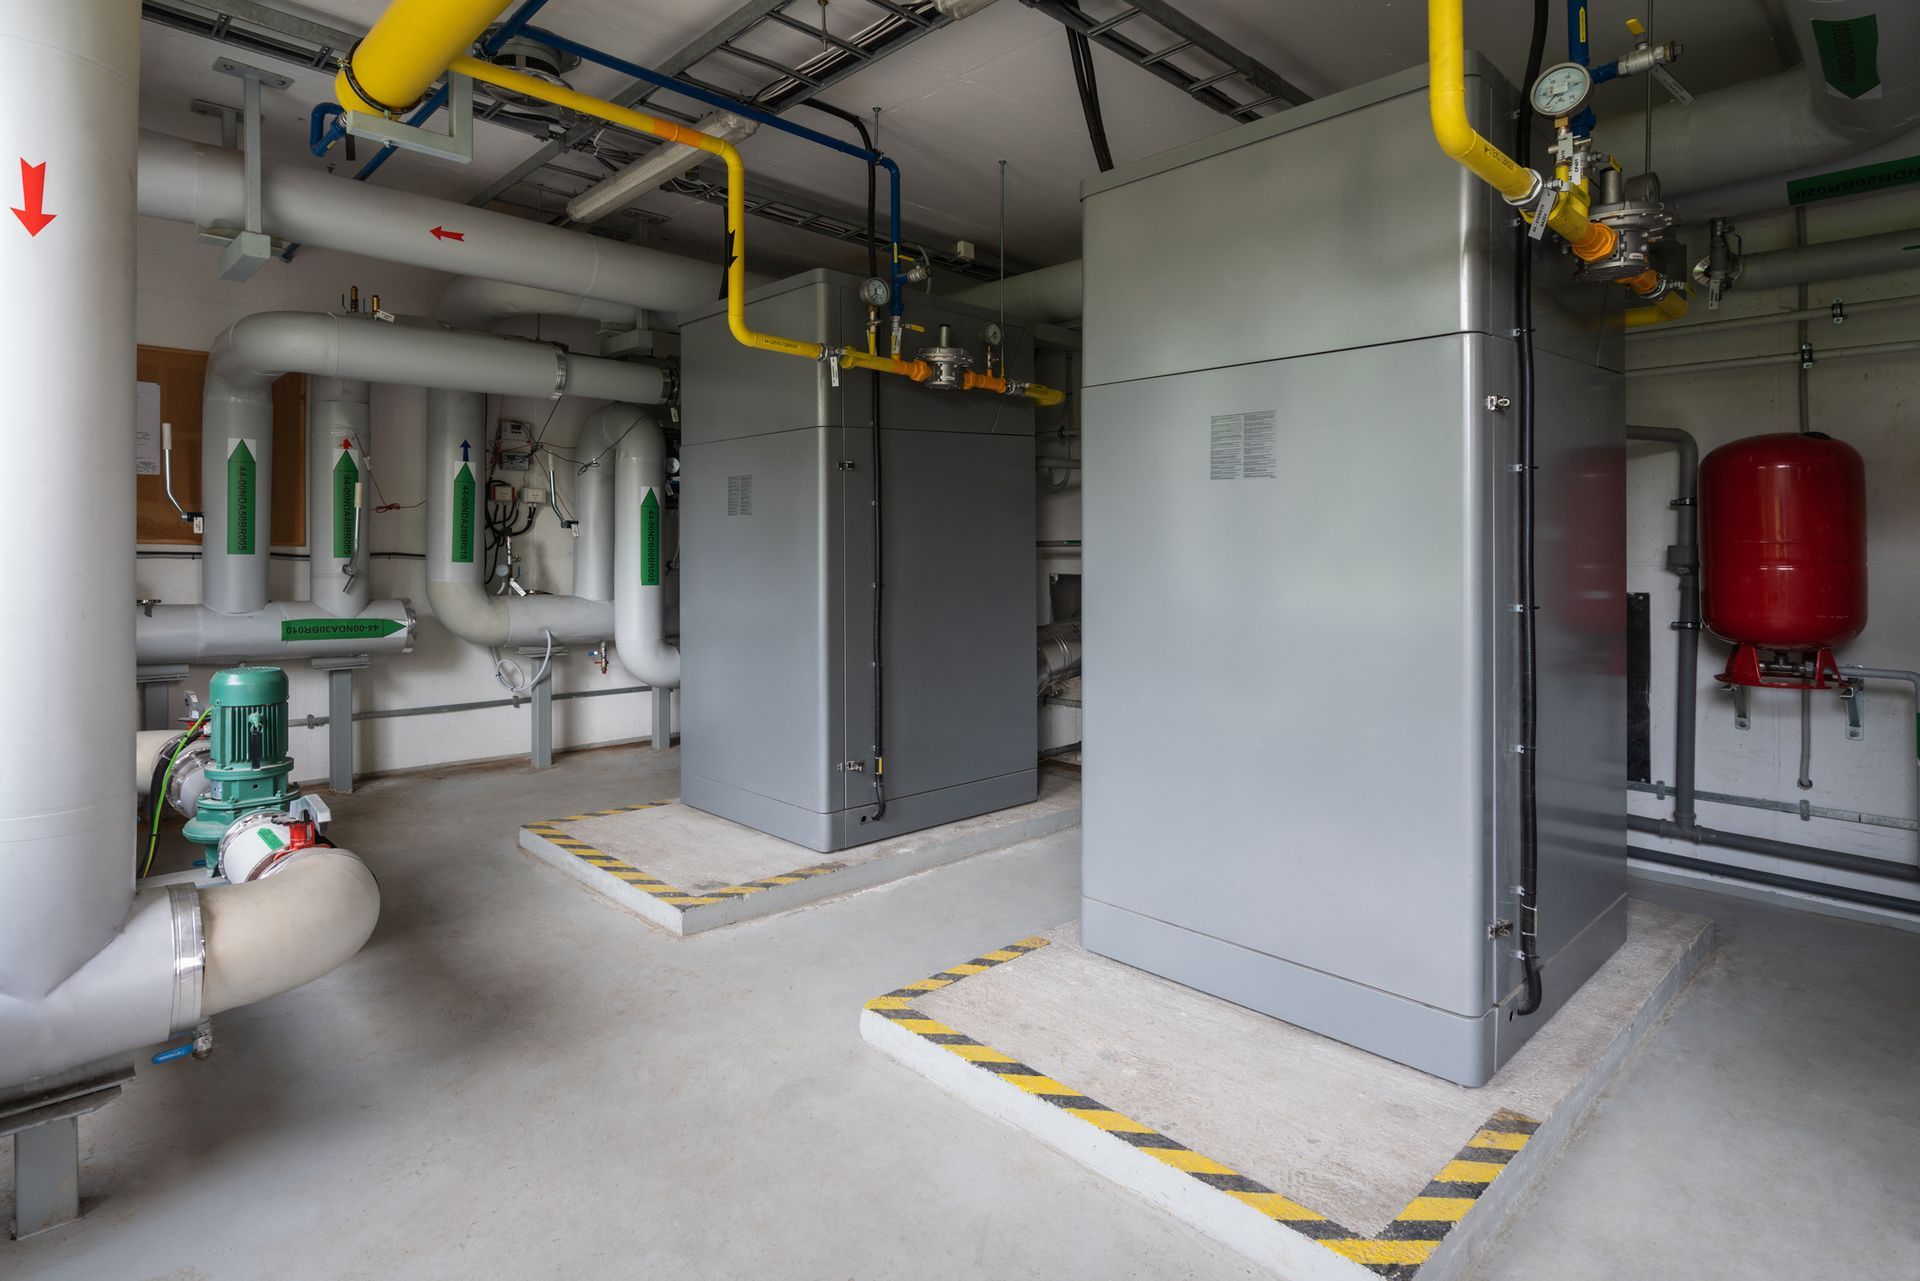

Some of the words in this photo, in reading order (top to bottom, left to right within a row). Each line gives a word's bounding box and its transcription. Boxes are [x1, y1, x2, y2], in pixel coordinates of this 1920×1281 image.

[237, 466, 248, 551] 44-00NDA50BR005
[342, 475, 352, 555] 44-00NDA40BR005
[460, 485, 469, 560] 44-00NDA20BR010
[286, 624, 379, 635] 44-00NDA30BR010
